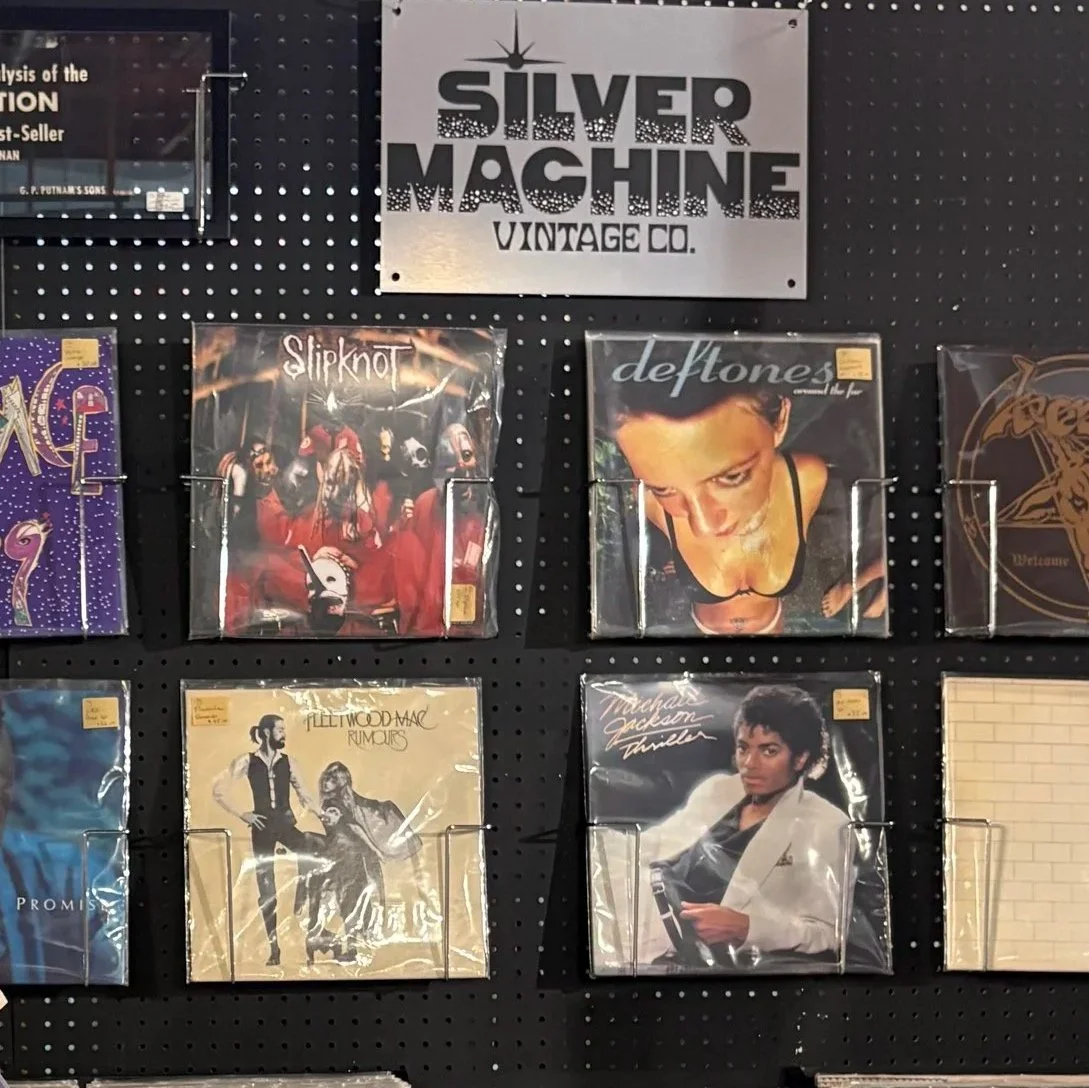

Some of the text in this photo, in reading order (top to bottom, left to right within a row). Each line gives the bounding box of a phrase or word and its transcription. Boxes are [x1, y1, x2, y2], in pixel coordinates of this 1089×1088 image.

[42, 64, 59, 82] of
[64, 64, 89, 82] the
[437, 69, 752, 146] SILVER
[40, 185, 82, 195] PUTNAM'S
[84, 185, 106, 195] SONS
[386, 143, 801, 220] MACHINE
[493, 222, 697, 254] VINTAGE CO.
[612, 338, 834, 398] deftones
[1012, 554, 1070, 568] Welcome
[304, 704, 438, 733] FLEETWOOD MAC
[604, 712, 715, 752] Jackson
[347, 729, 409, 752] RUMOURS
[622, 729, 718, 761] Thriller
